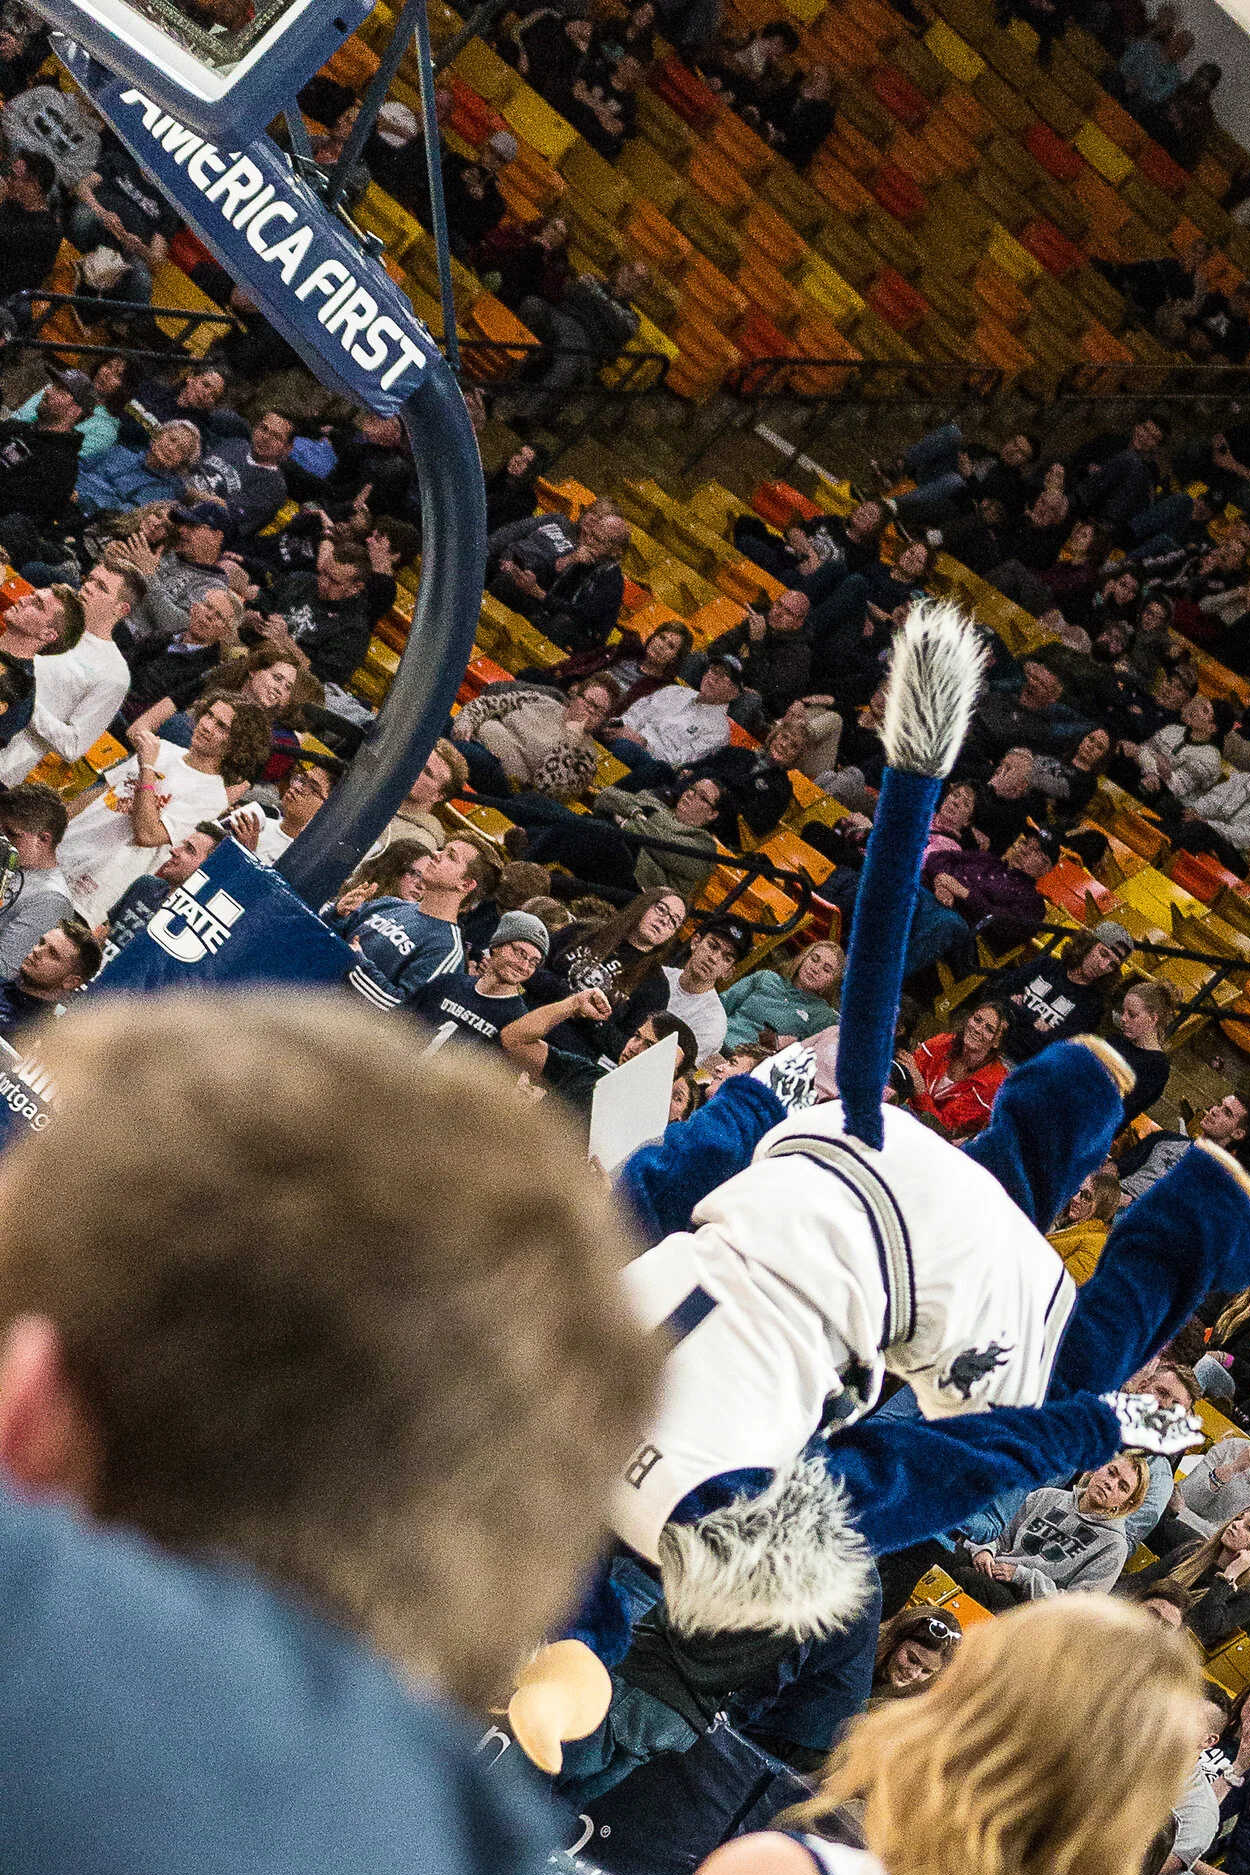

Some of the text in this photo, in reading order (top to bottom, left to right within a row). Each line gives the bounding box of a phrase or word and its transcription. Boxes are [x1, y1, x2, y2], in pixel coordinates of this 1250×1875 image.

[295, 259, 427, 391] FIRST
[161, 887, 232, 955] STATE
[363, 913, 417, 956] adidas
[440, 998, 498, 1039] UTAH STATE
[1026, 1516, 1087, 1559] STATE
